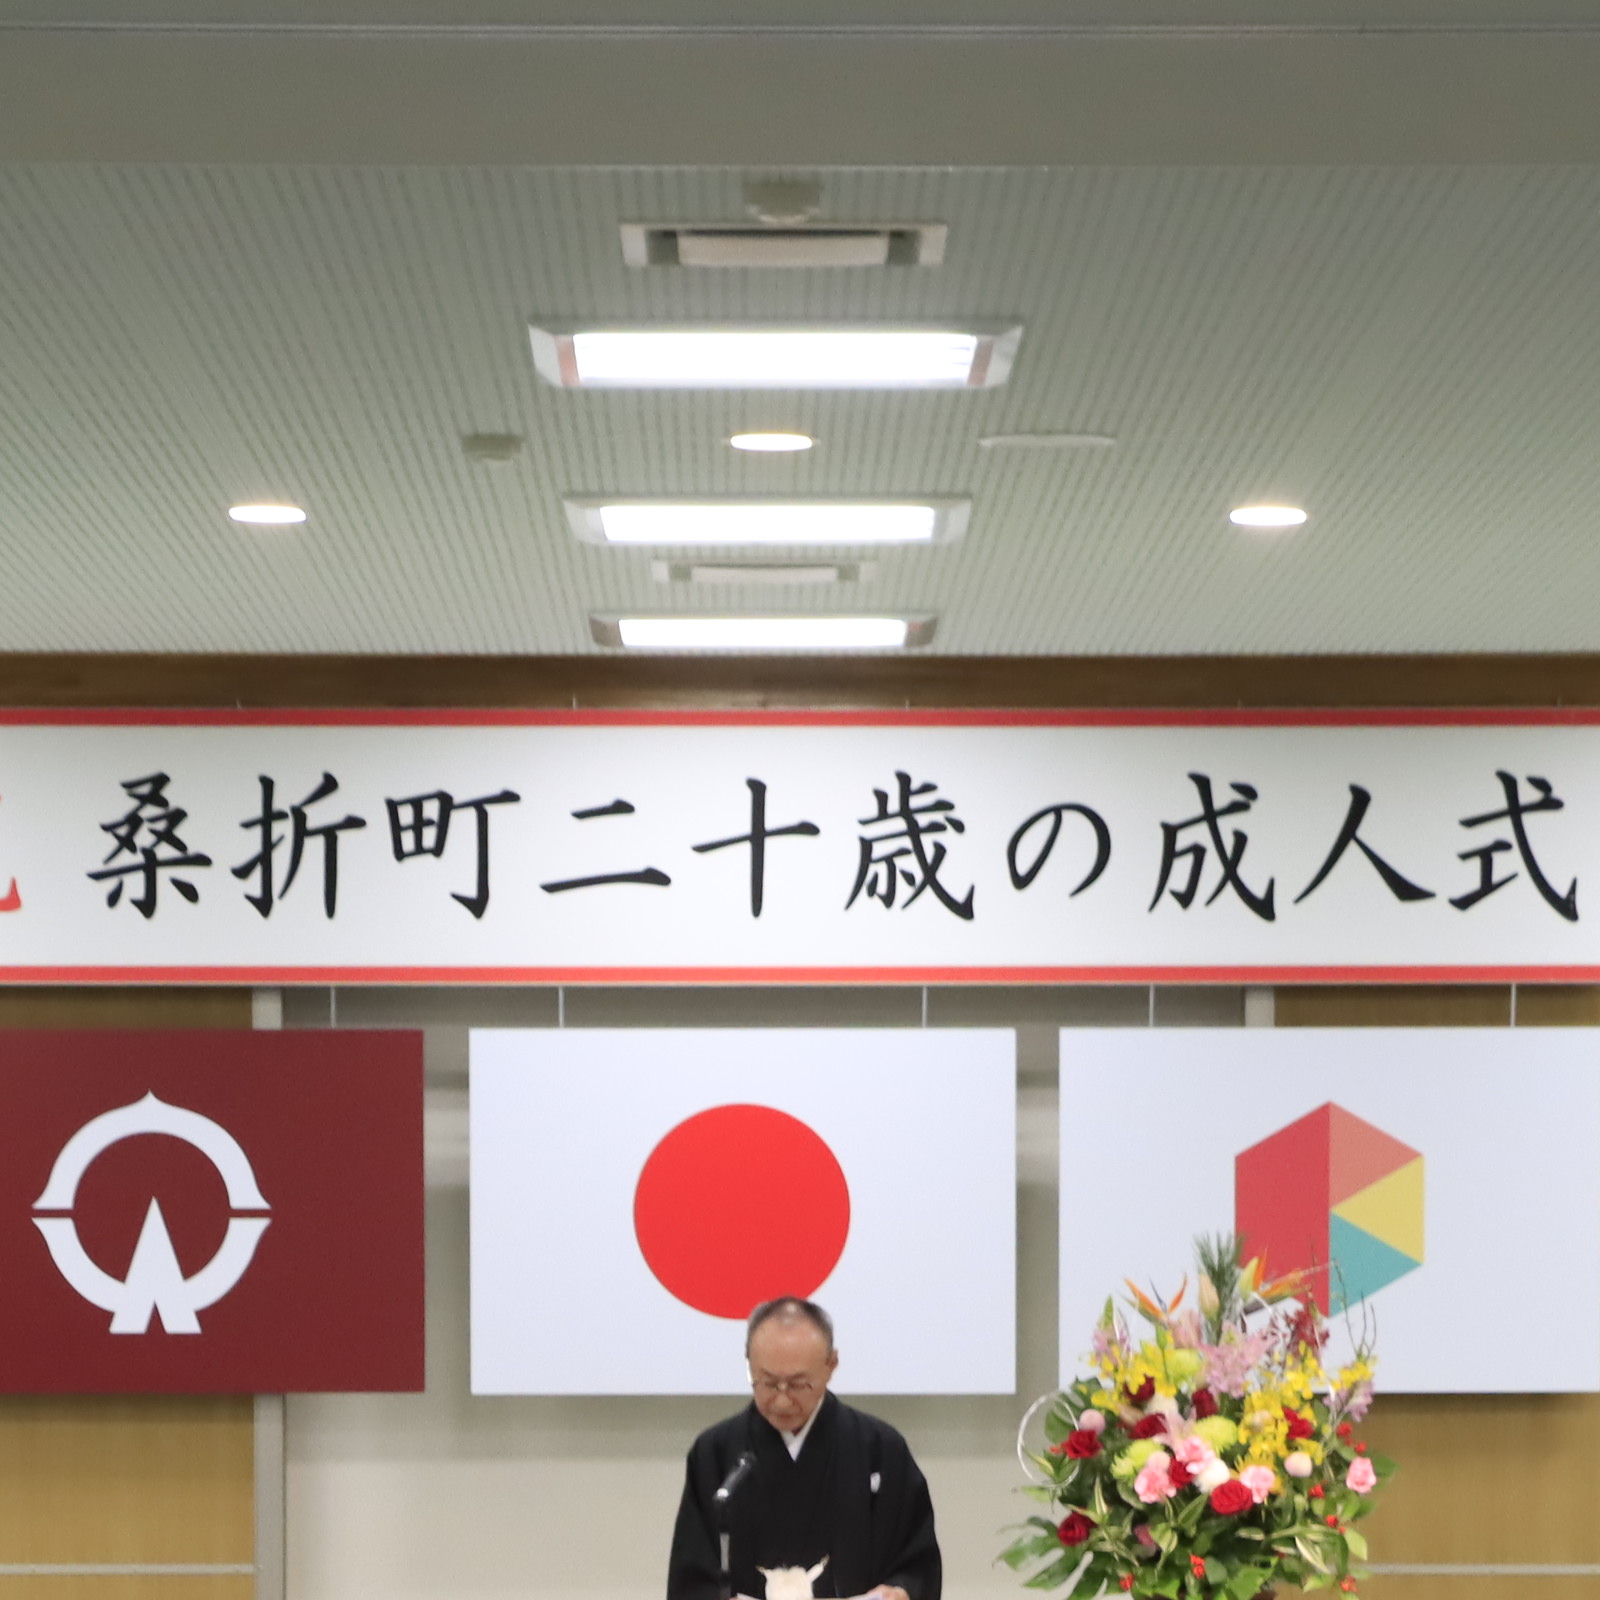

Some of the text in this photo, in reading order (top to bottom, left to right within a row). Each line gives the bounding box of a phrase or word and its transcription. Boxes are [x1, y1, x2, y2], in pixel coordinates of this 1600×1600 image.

[86, 769, 1579, 923] 桑折町二十歳の成人式
